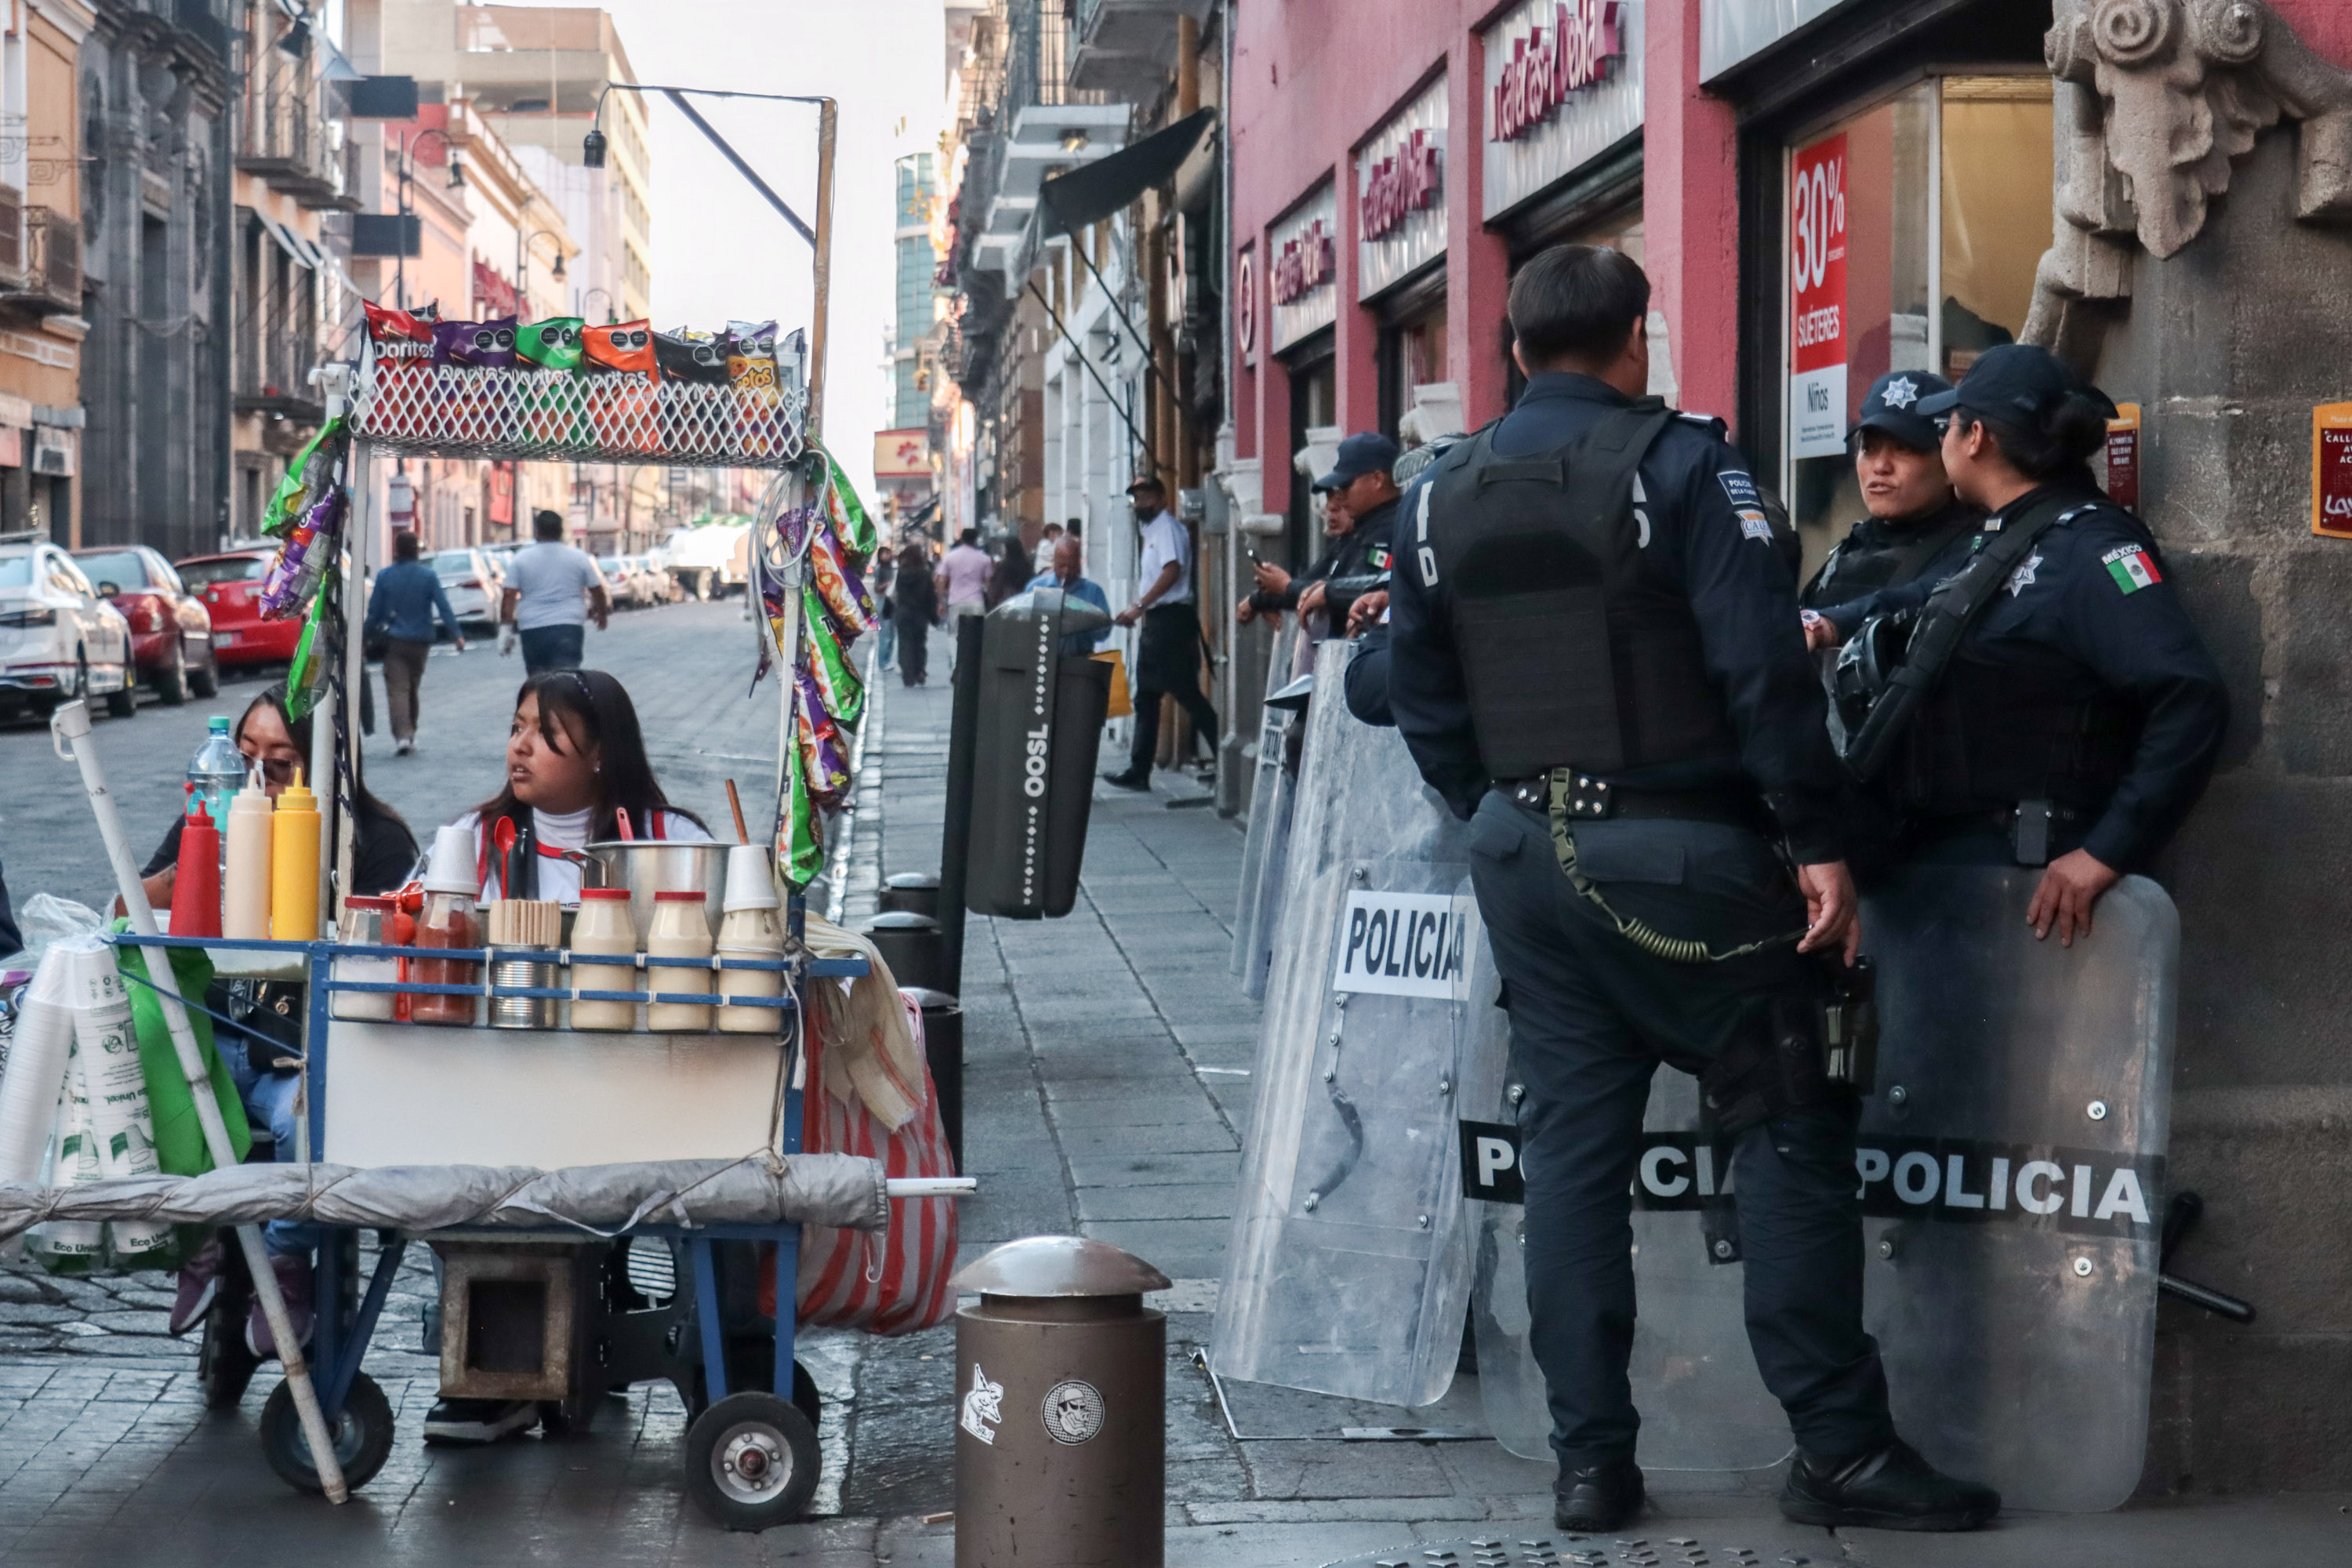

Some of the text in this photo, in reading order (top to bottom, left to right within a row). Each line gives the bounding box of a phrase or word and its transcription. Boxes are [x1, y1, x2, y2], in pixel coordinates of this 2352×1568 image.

[1794, 155, 1845, 294] 30%
[1798, 304, 1840, 347] SUÉTERES
[375, 340, 434, 359] Doritos
[1808, 382, 1828, 414] Niños
[2101, 543, 2143, 565] MÉXICO
[1024, 723, 1049, 798] OOSL
[1344, 907, 1465, 983] POLICIA
[1855, 1148, 2151, 1224] POLICIA
[54, 1241, 72, 1253] Eco
